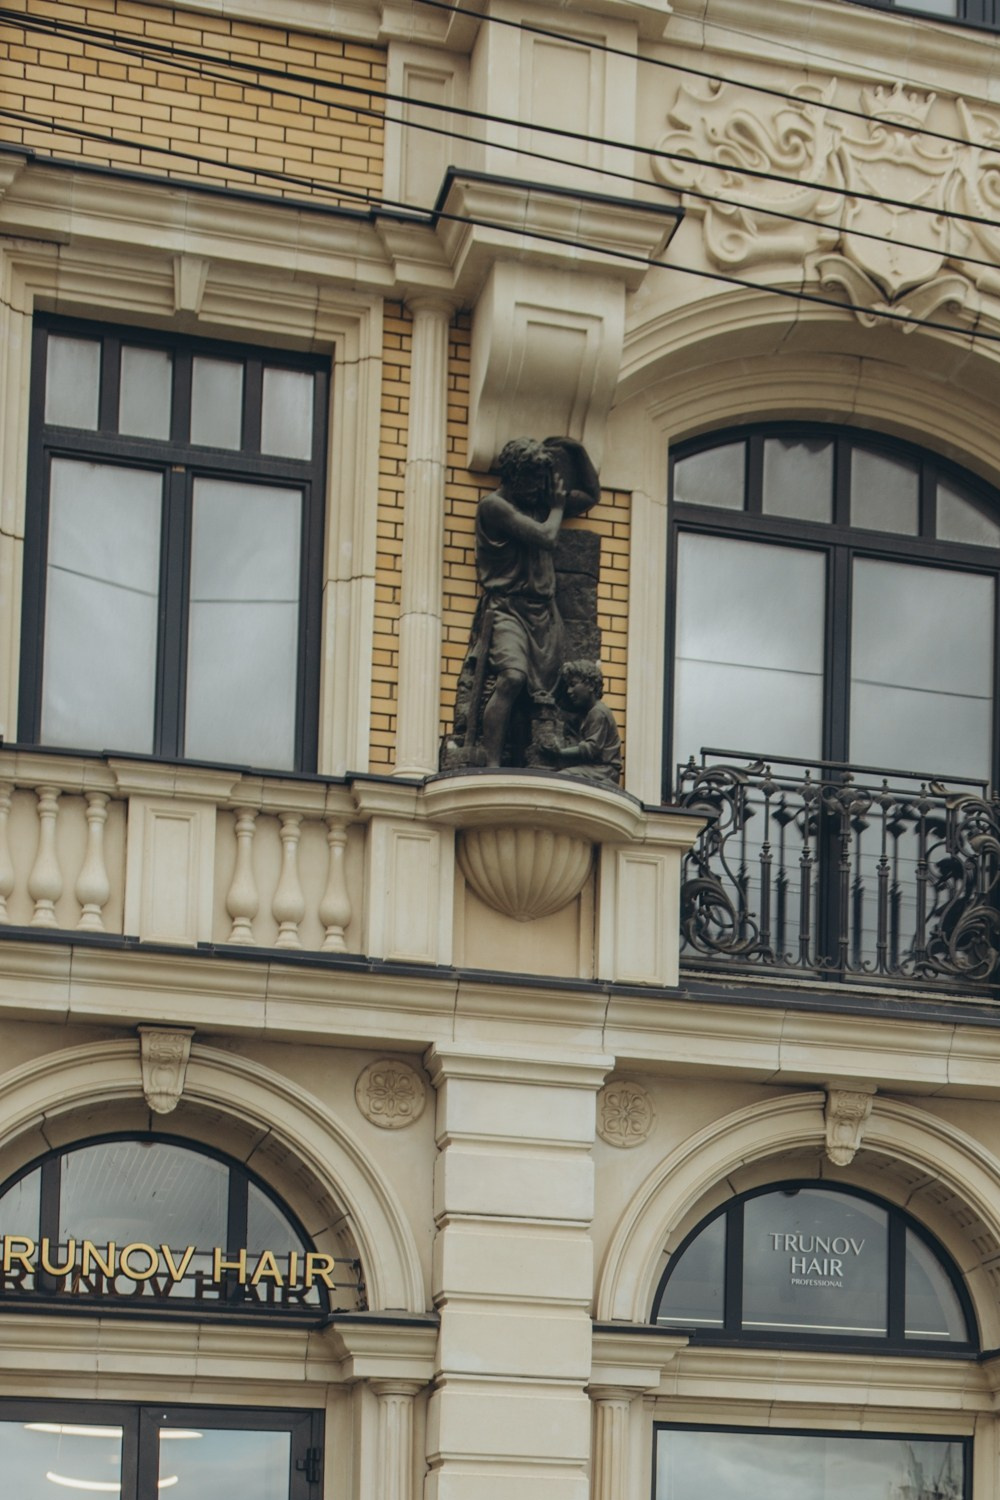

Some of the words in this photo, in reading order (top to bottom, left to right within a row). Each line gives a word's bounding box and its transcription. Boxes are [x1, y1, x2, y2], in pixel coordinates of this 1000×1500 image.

[769, 1232, 866, 1256] TRUNOV
[212, 1246, 337, 1291] HAIR
[790, 1256, 844, 1277] HAIR
[791, 1278, 844, 1288] PROFESSIONAL
